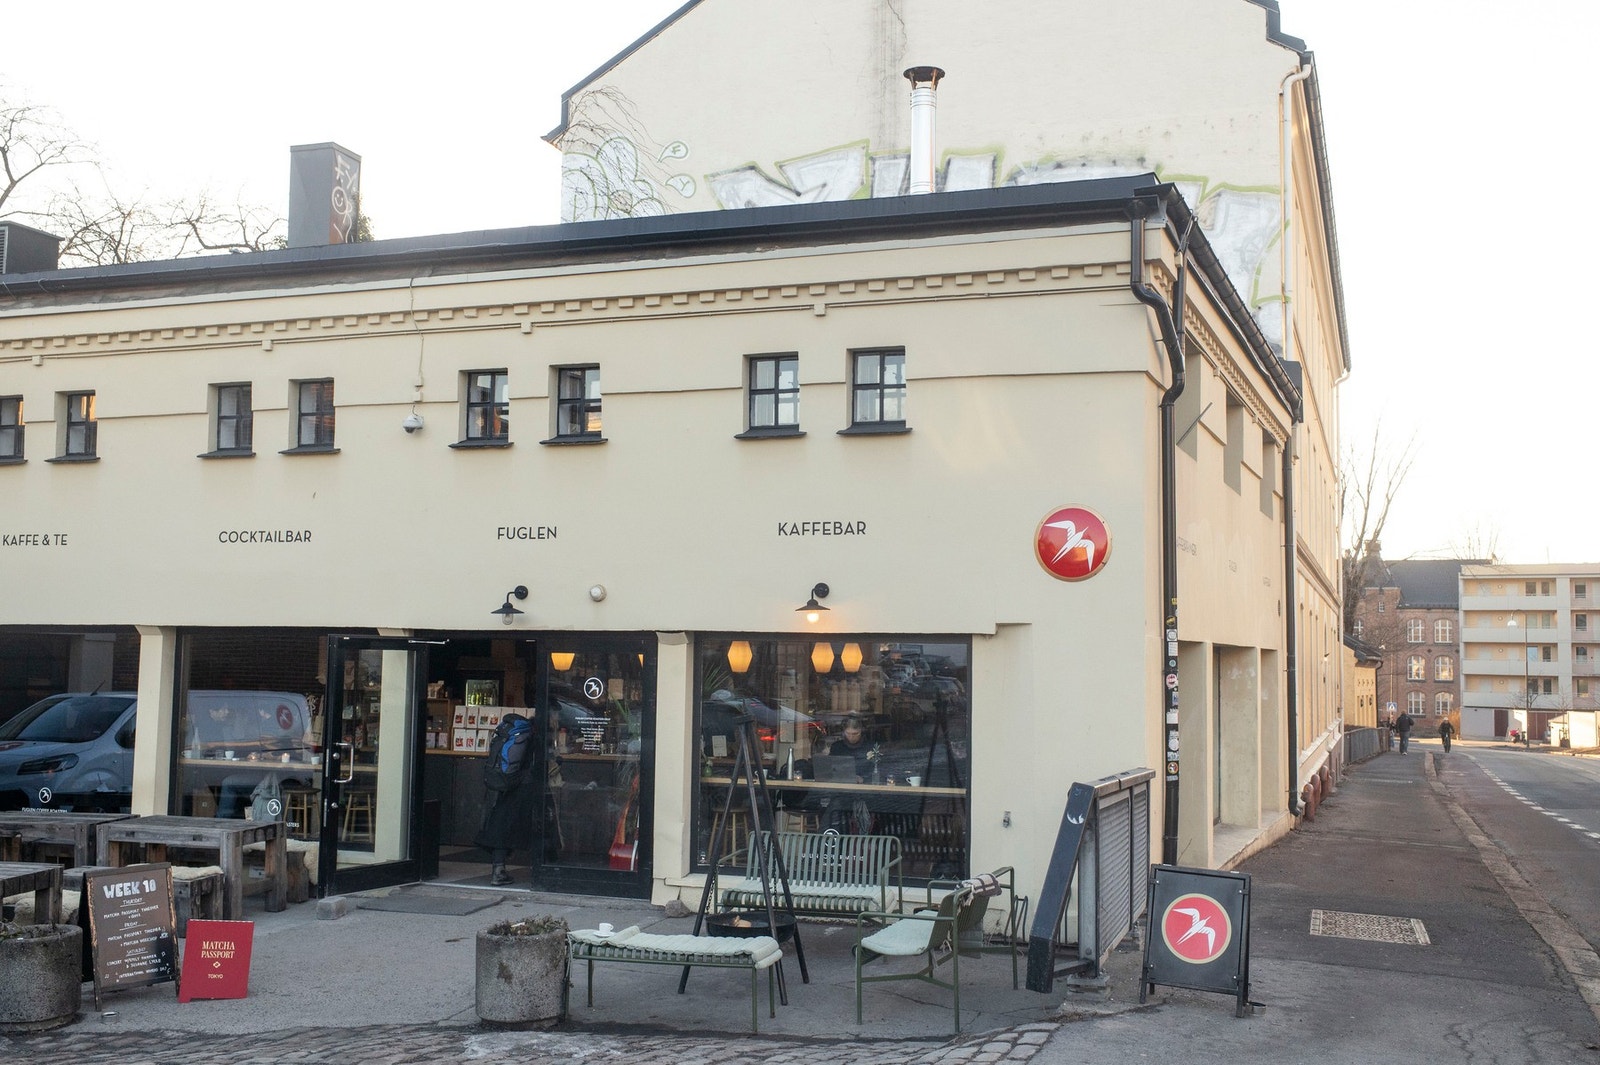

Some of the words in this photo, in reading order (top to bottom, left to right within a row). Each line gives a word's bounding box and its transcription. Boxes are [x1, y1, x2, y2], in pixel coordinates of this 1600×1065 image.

[497, 526, 557, 540] FUGLEN
[777, 520, 867, 537] KAFFEBAR
[2, 534, 39, 546] KAFFE
[41, 534, 50, 546] &
[54, 534, 68, 546] TE
[218, 530, 312, 544] COCKTAILBAR
[103, 881, 140, 899] WEEK
[142, 879, 157, 893] 10
[202, 941, 235, 950] MATCHA
[201, 951, 235, 959] PASSPORT
